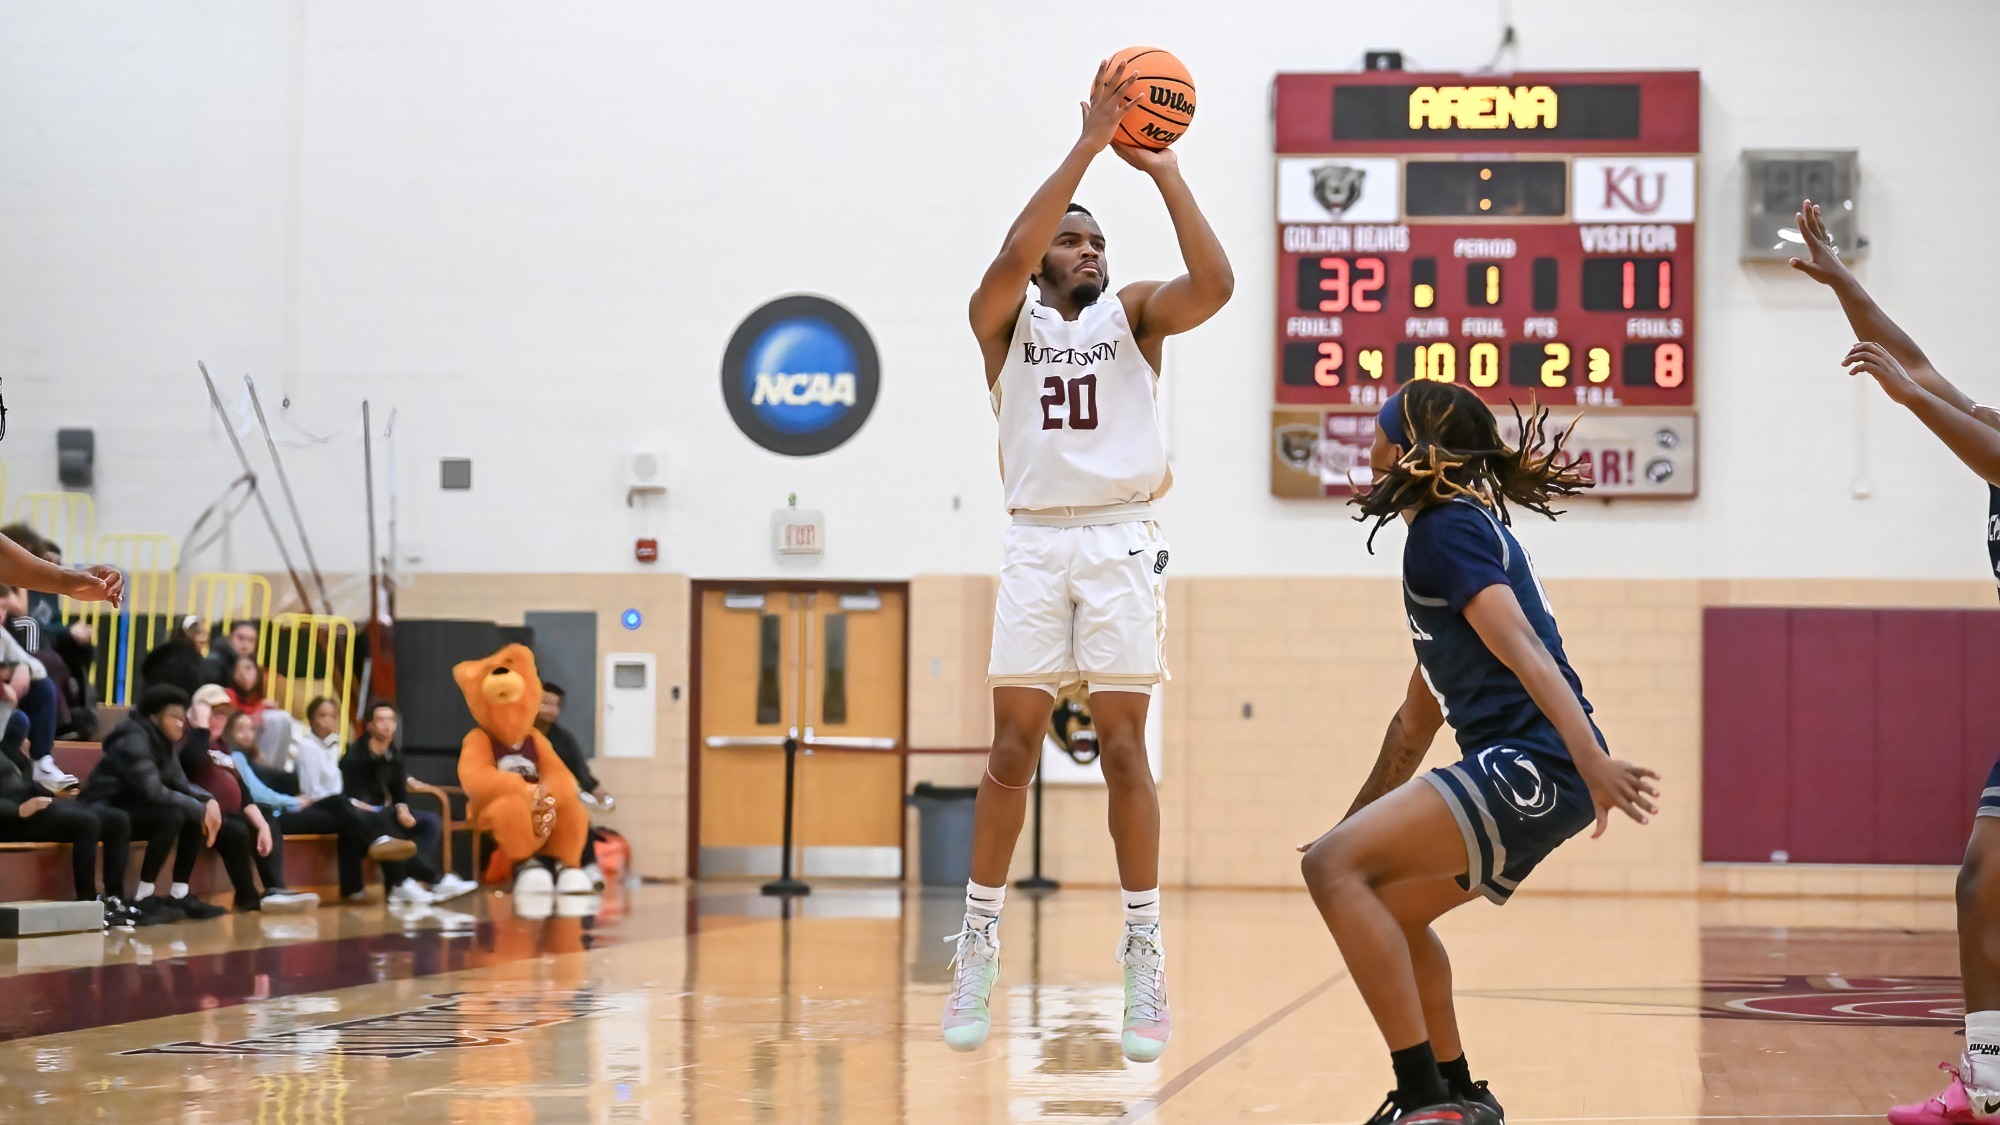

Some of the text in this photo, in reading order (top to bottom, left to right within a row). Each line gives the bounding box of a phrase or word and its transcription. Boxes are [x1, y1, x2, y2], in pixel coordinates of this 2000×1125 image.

[1409, 86, 1557, 129] ARENA
[1602, 166, 1668, 215] KU
[1283, 225, 1410, 252] GOLDEN BEARS
[1453, 238, 1516, 258] PERIOD
[1580, 225, 1677, 253] VISITOR
[1319, 257, 1385, 312] 32
[1486, 266, 1499, 304] 1
[1623, 260, 1671, 309] 11
[1287, 316, 1343, 337] FOULS
[1627, 318, 1684, 338] FOULS
[1023, 340, 1119, 366] KUTZTOWN
[1315, 342, 1343, 386] 2
[1359, 350, 1382, 379] 4
[1415, 343, 1456, 383] 10
[1469, 343, 1498, 387] 0
[1541, 343, 1570, 387] 2
[1588, 348, 1610, 382] 3
[1655, 343, 1684, 388] 8
[751, 372, 856, 406] NCAA
[1040, 373, 1098, 430] 20
